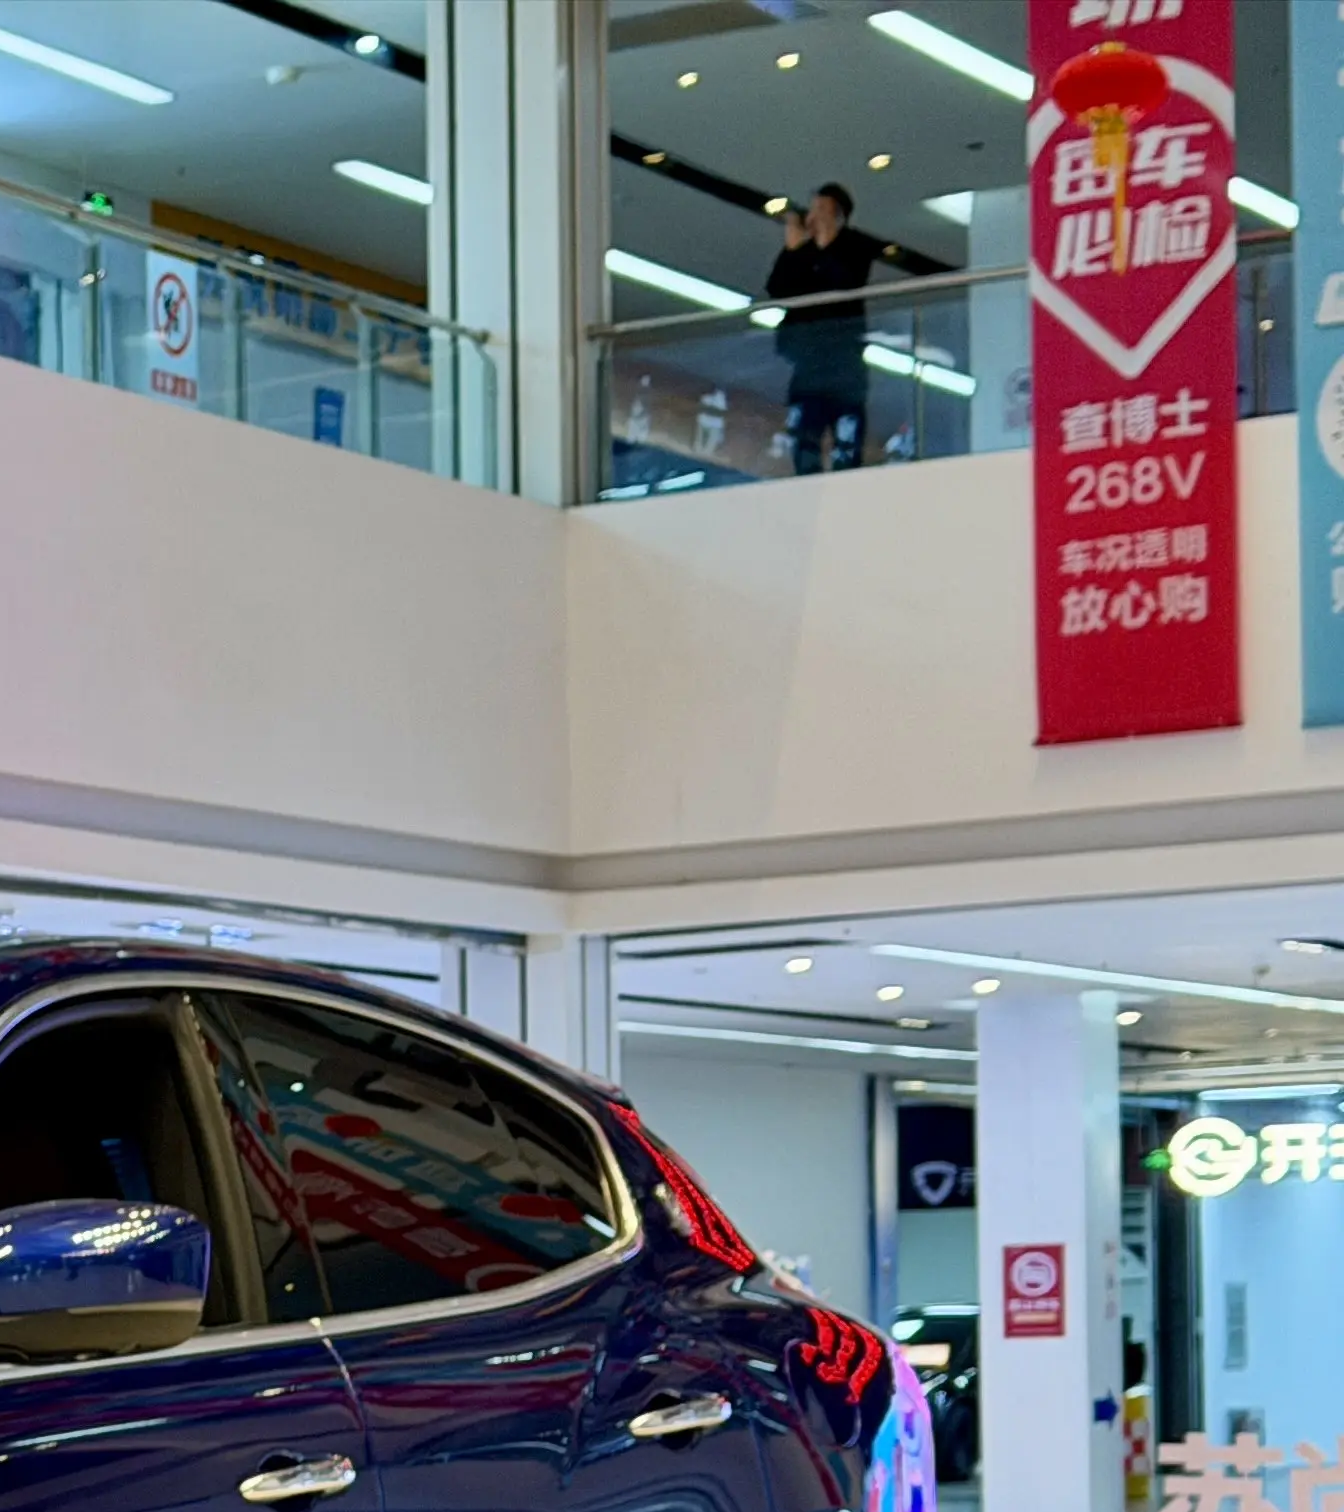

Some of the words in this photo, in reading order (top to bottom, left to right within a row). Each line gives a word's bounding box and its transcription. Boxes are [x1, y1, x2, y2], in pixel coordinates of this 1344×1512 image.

[1060, 388, 1209, 454] 查博士
[1065, 451, 1206, 514] 268V
[1059, 524, 1208, 576] 车况透明
[1060, 573, 1208, 637] 放心购
